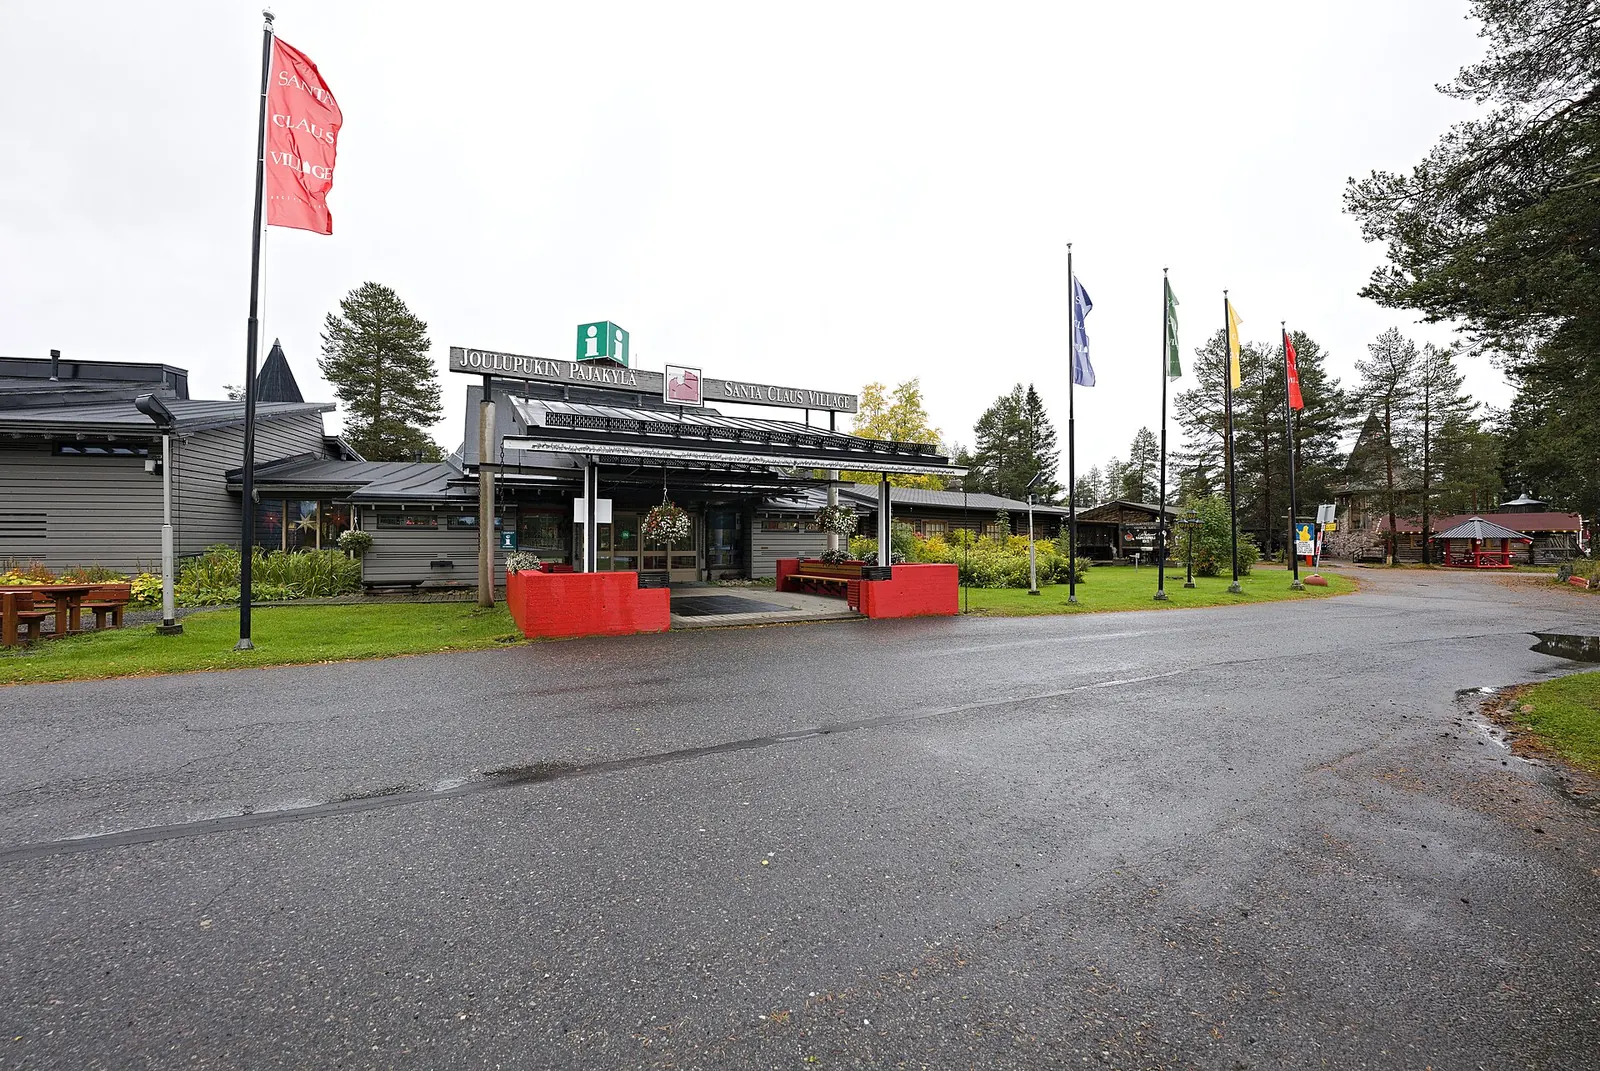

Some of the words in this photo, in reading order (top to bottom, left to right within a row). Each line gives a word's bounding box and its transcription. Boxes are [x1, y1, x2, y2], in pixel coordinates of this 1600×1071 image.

[278, 70, 335, 106] SANTA
[273, 114, 335, 144] CLAUS
[460, 350, 560, 377] JOULUPUKIN
[569, 362, 637, 386] PAJAKYLÄ
[724, 381, 762, 400] SANTA
[767, 387, 803, 404] CLAUS
[808, 391, 850, 409] VILLAGE
